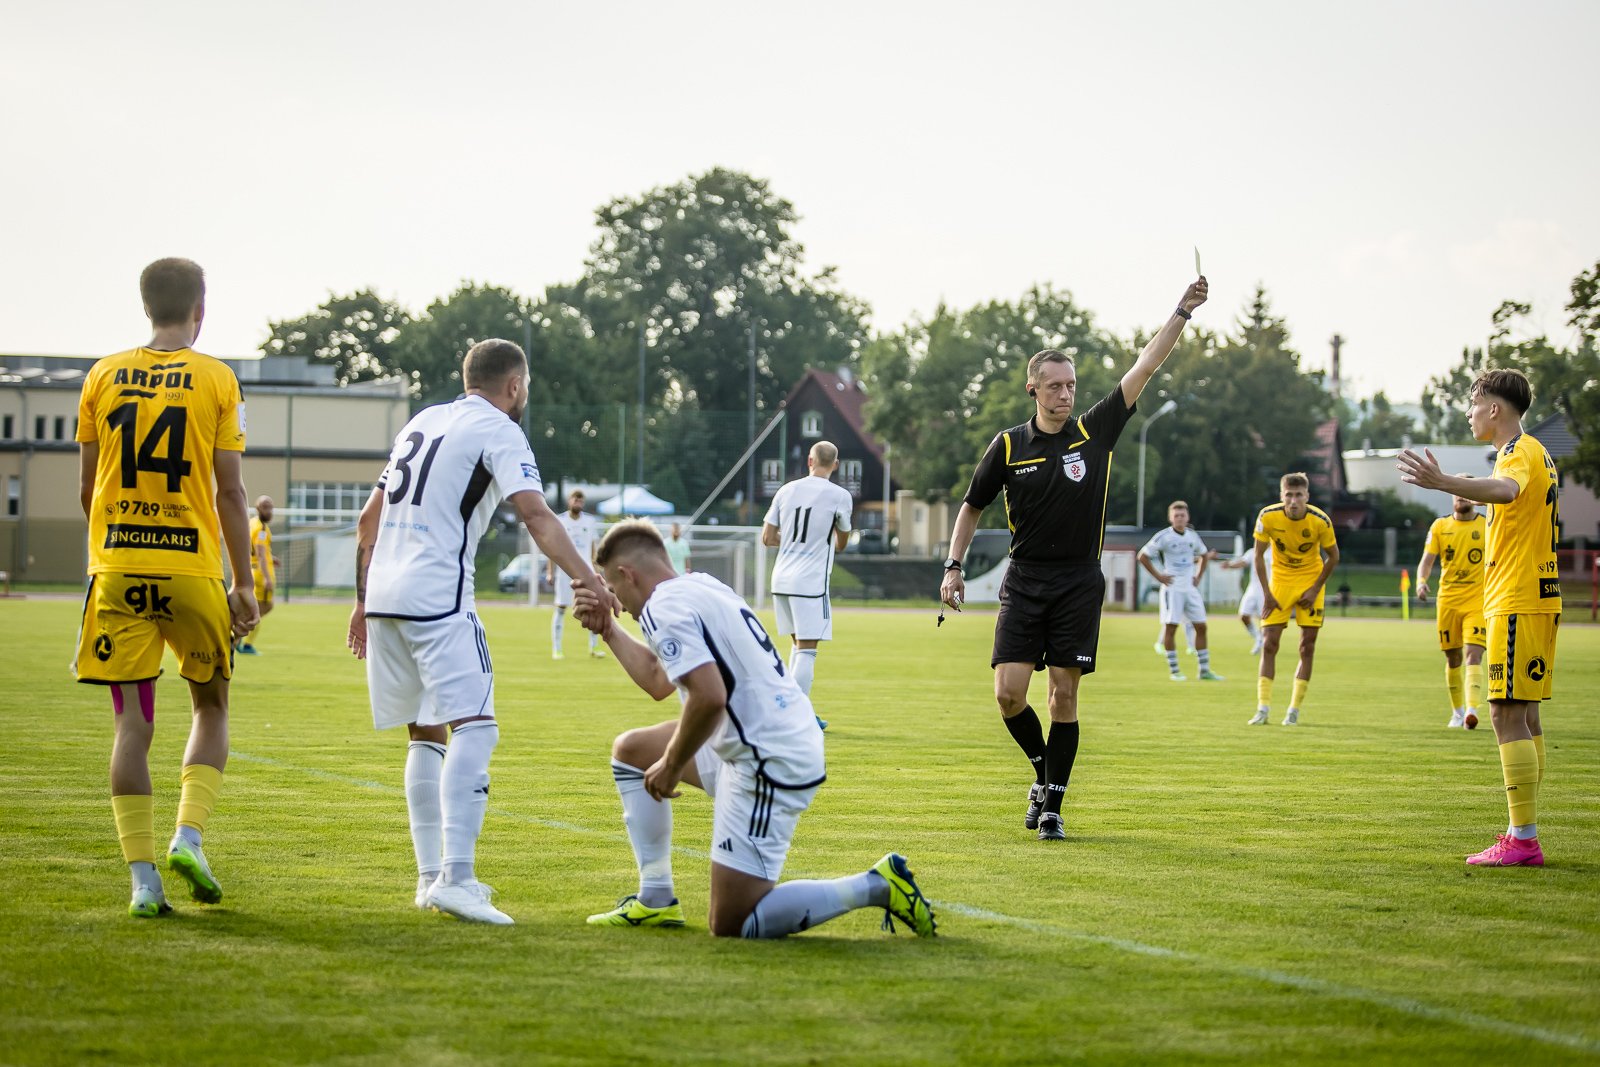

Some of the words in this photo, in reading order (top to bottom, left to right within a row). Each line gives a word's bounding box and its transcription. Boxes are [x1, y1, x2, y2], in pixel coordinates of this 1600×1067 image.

[113, 367, 194, 391] ARPOL
[164, 391, 185, 401] 1991
[106, 401, 193, 493] 14
[387, 431, 446, 507] 31
[110, 530, 193, 547] SINGULARIS
[792, 505, 813, 544] 11
[124, 583, 174, 615] gk
[739, 607, 785, 678] 9
